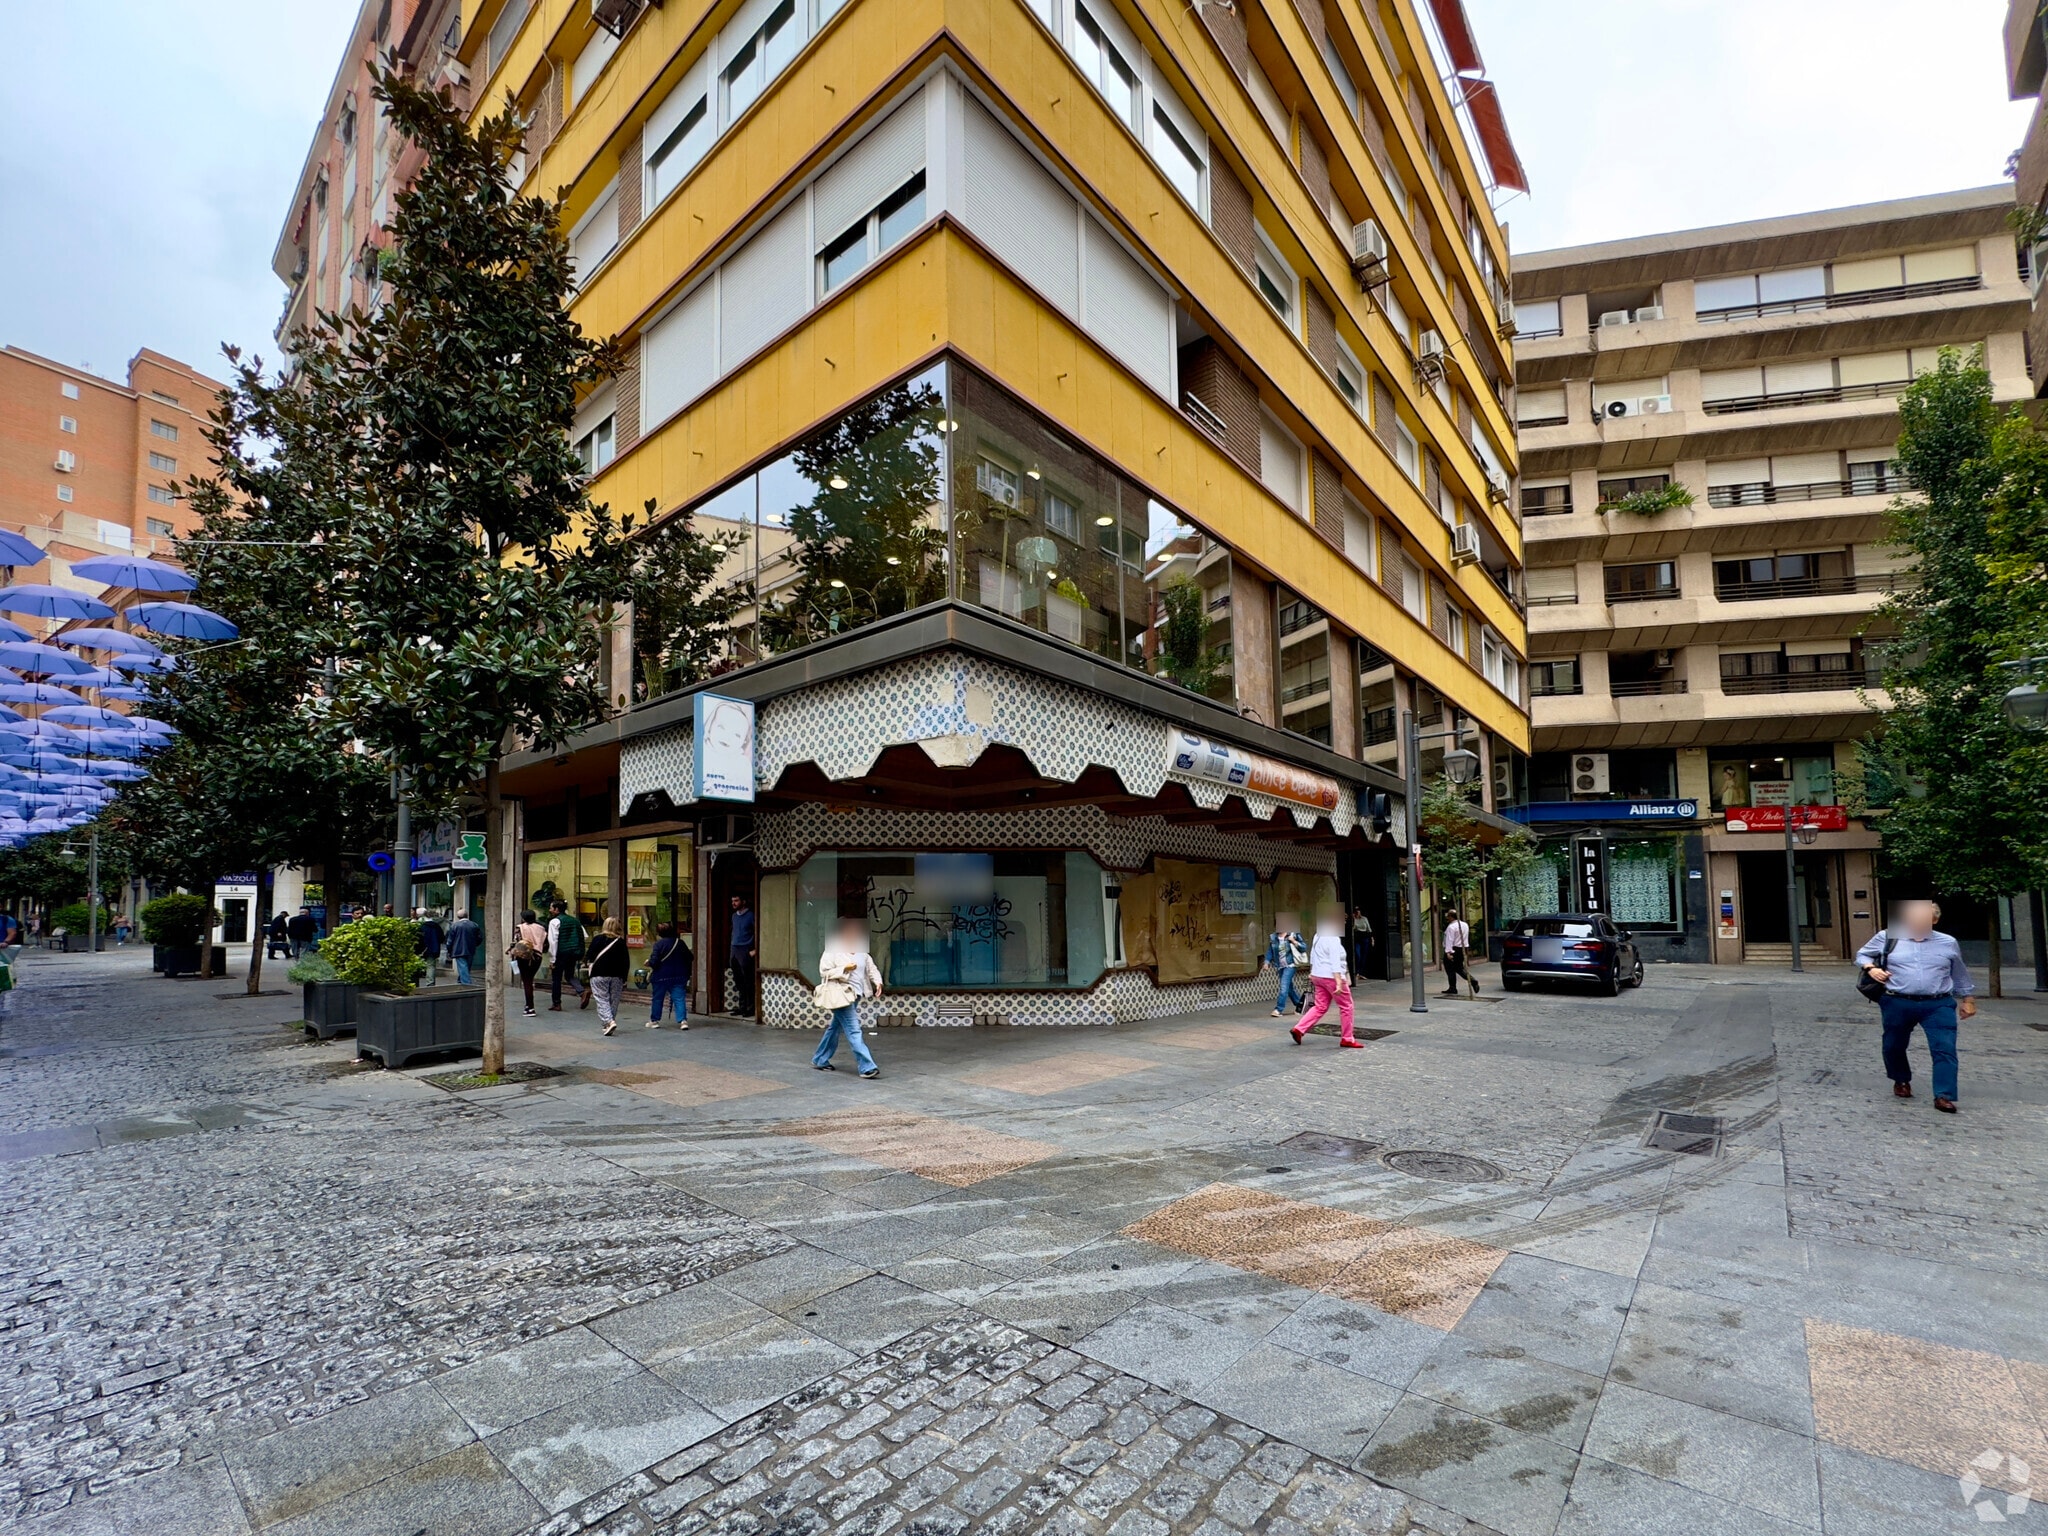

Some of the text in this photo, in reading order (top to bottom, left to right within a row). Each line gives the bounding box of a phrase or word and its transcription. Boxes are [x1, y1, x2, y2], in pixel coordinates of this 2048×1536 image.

[1629, 804, 1675, 815] Allianz
[1756, 810, 1787, 821] Atelie
[1583, 846, 1598, 909] la pelu
